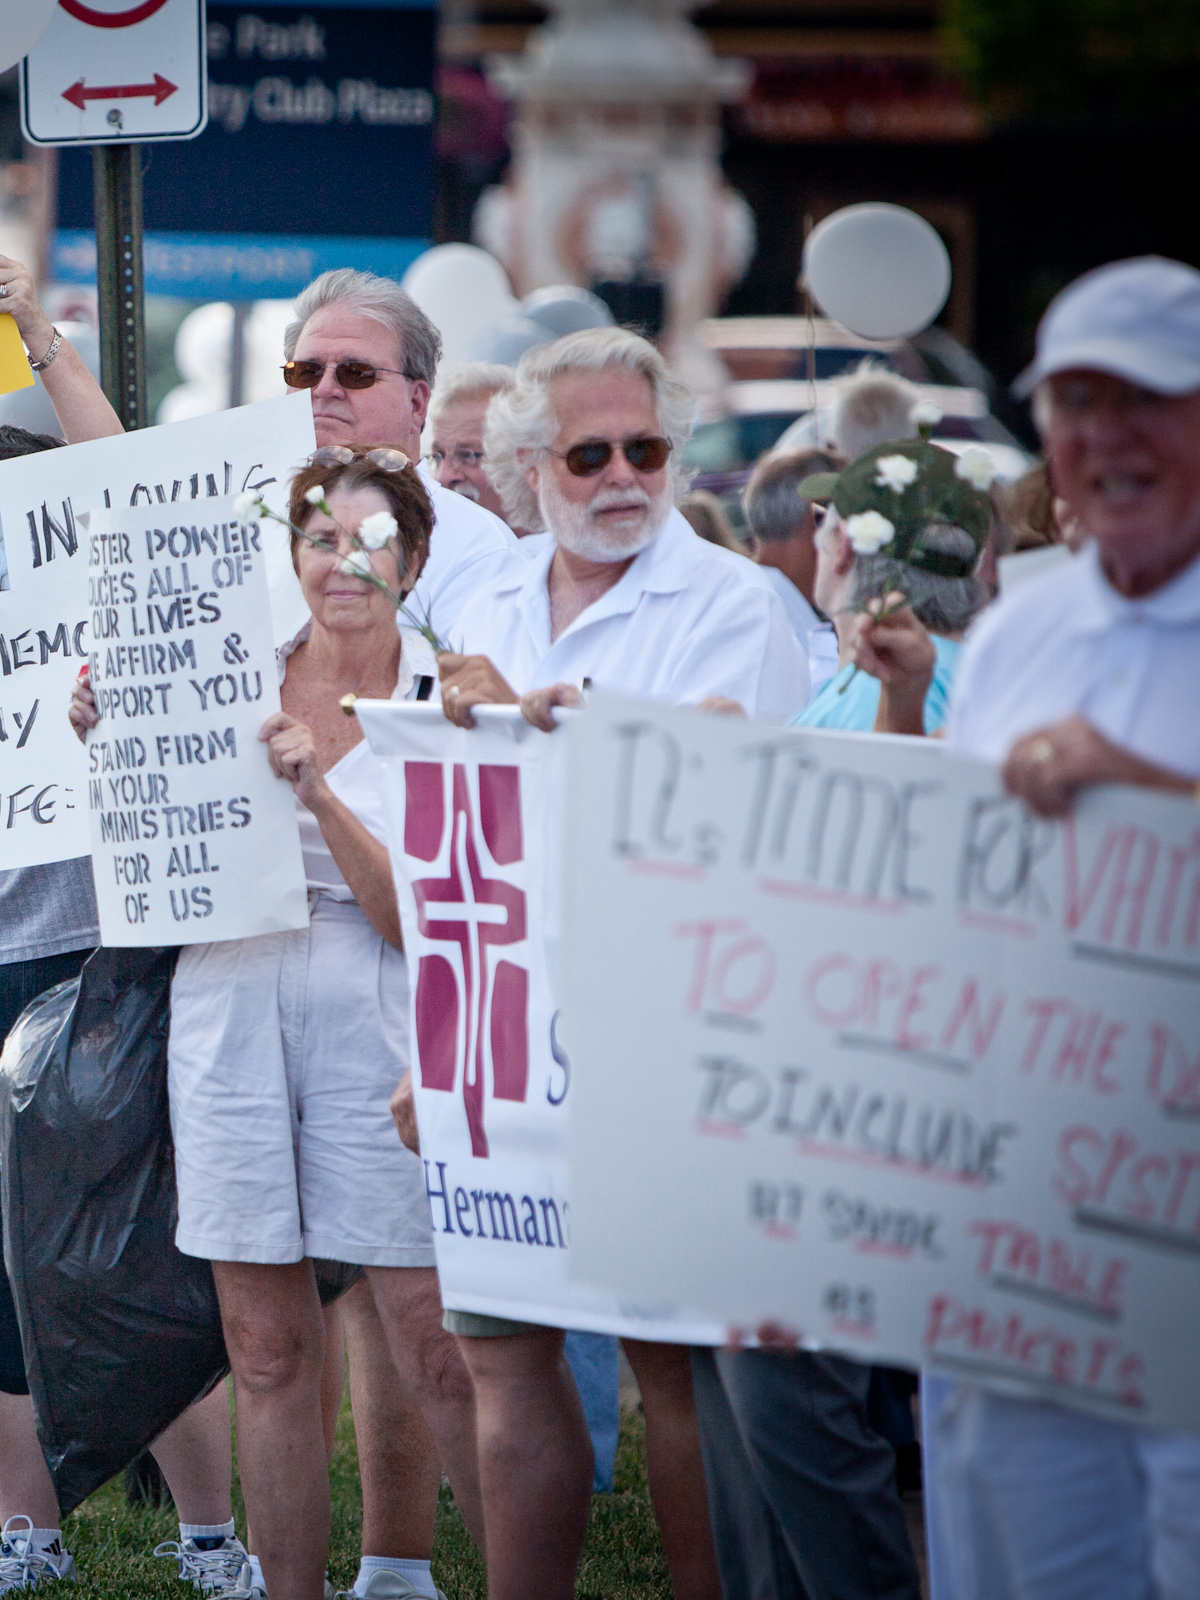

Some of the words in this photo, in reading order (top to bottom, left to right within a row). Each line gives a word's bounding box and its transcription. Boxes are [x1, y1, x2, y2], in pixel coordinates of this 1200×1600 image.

[26, 496, 79, 569] IN
[145, 521, 262, 560] POWER
[147, 563, 199, 599] ALL
[212, 554, 252, 588] OF
[93, 607, 120, 639] OUR
[131, 592, 222, 636] LIVES
[105, 639, 197, 679] AFFIRM
[224, 632, 250, 665] &
[189, 671, 263, 711] YOU
[89, 736, 147, 774] STAND
[156, 727, 237, 766] FIRM
[88, 778, 104, 810] IN
[108, 773, 170, 808] YOUR
[100, 796, 252, 843] MINISTRIES
[114, 852, 151, 885] FOR
[166, 842, 219, 877] ALL
[125, 892, 151, 924] OF
[169, 886, 214, 922] US
[674, 919, 780, 1019] TO
[806, 952, 1008, 1070] OPEN
[1019, 995, 1129, 1094] THE
